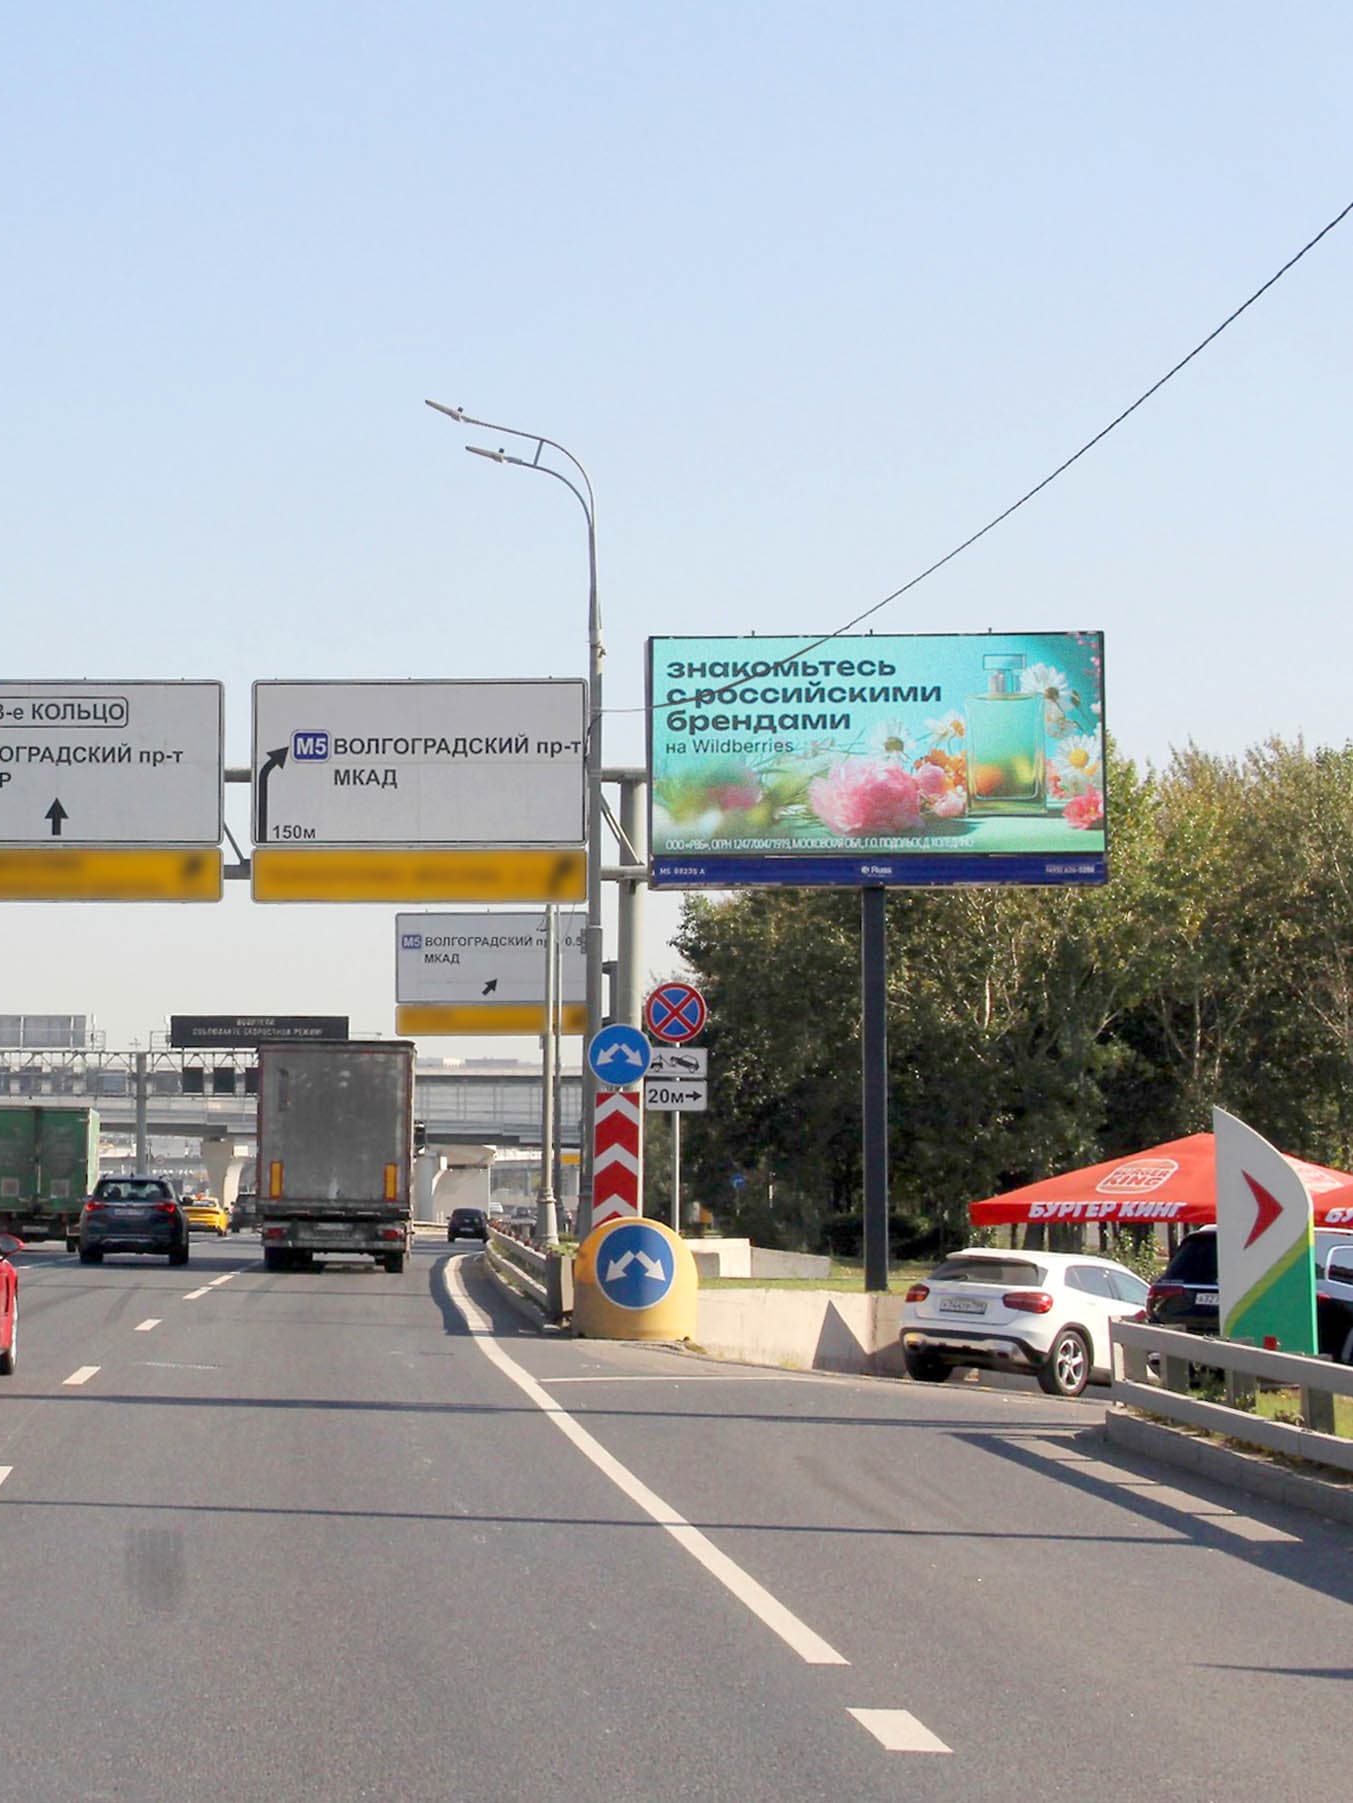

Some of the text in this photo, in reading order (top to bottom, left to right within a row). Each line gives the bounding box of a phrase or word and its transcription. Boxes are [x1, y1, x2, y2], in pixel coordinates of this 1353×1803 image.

[667, 659, 896, 679] знакомьтесь
[666, 681, 941, 708] с российскими
[31, 703, 125, 723] КОЛЬЦО
[666, 710, 851, 735] брендами
[333, 734, 529, 758] ВОЛГОГРАДСКИЙ
[536, 740, 582, 758] пр-т
[666, 738, 794, 754] на Wildberries
[139, 749, 183, 767] пр-т
[333, 769, 398, 789] МКАД
[272, 825, 316, 840] 150м
[425, 934, 533, 948] ВОЛГОГРАДСКИЙ
[424, 954, 460, 965] МКАД
[648, 1088, 684, 1104] 20м
[1102, 1176, 1164, 1186] KING
[1028, 1201, 1188, 1218] БУРГЕР КИНГ
